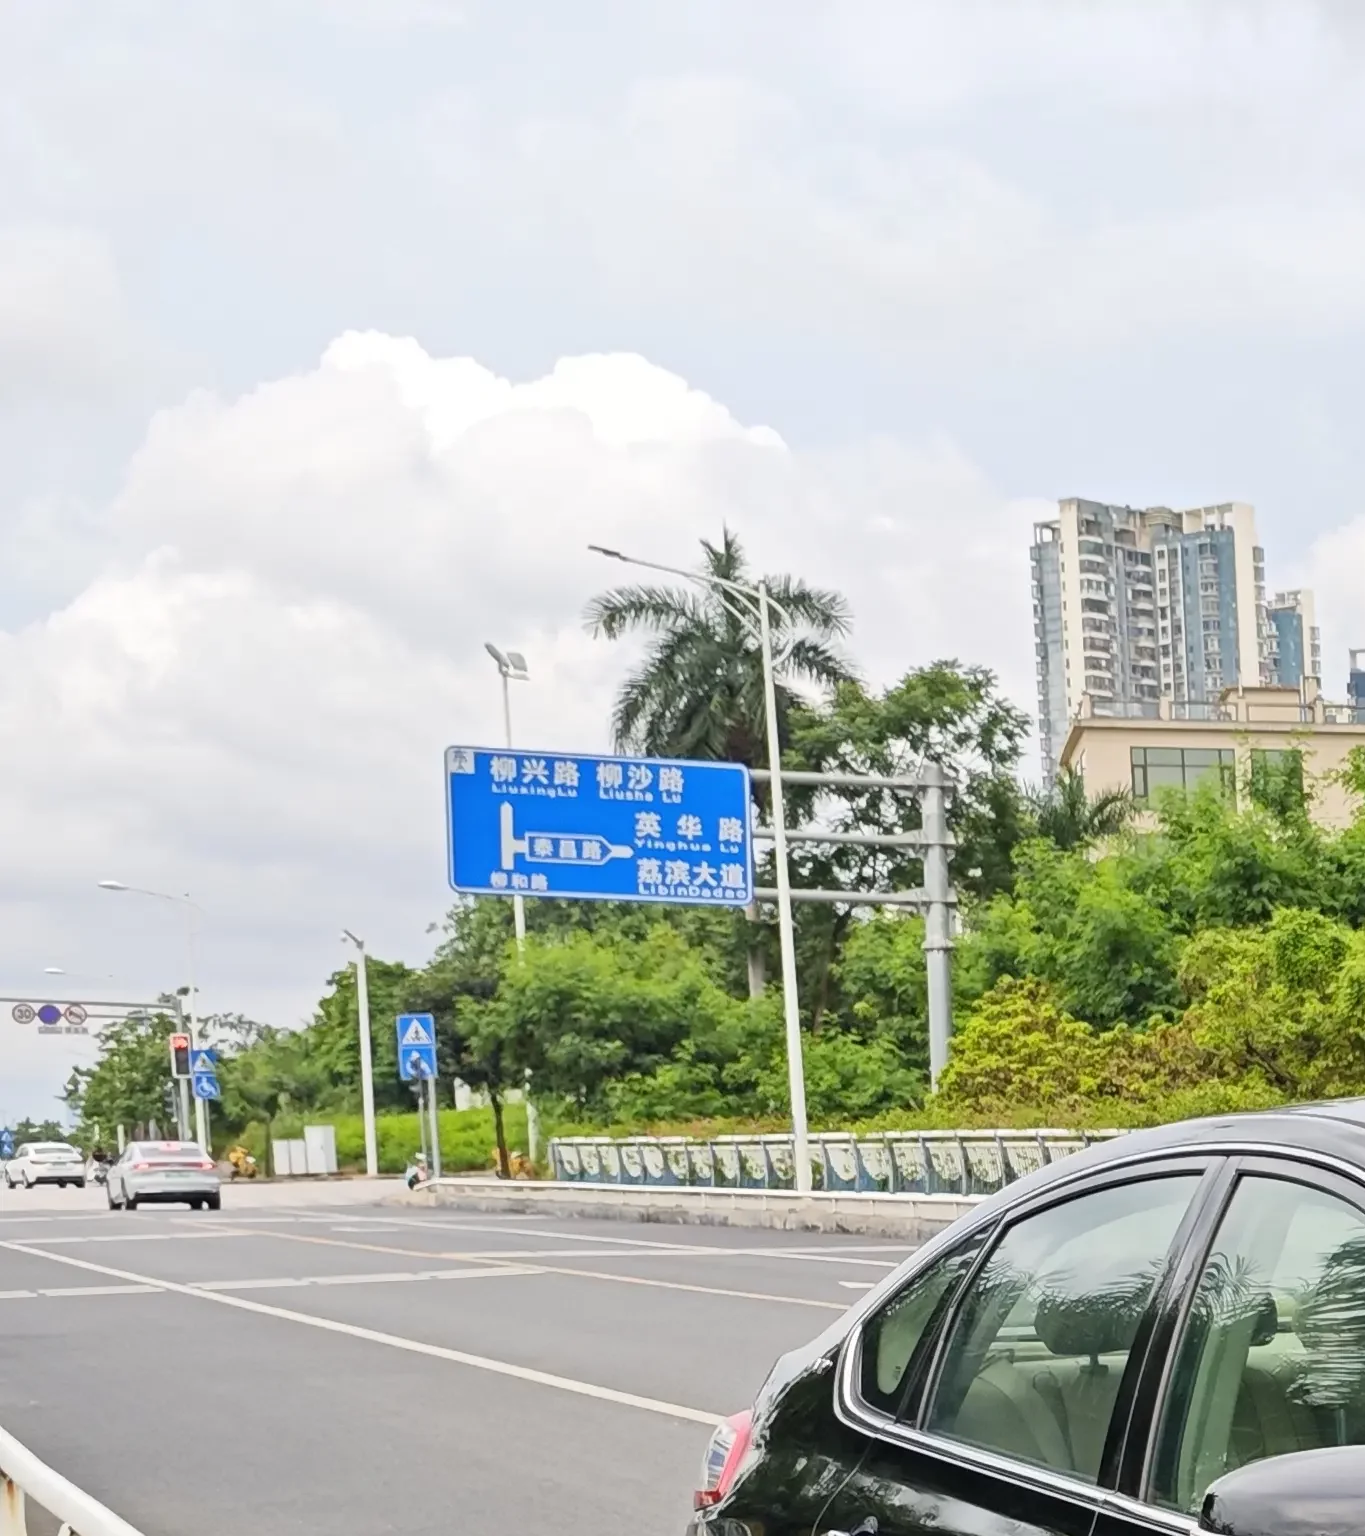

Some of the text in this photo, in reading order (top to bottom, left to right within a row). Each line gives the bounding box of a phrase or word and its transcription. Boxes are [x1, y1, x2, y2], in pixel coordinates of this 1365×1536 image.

[490, 756, 684, 793] 柳兴路 柳沙路
[662, 791, 681, 804] Lu
[634, 811, 744, 843] 英华路
[634, 838, 739, 854] Yinghua Lu
[637, 857, 746, 888] 荔滨大道
